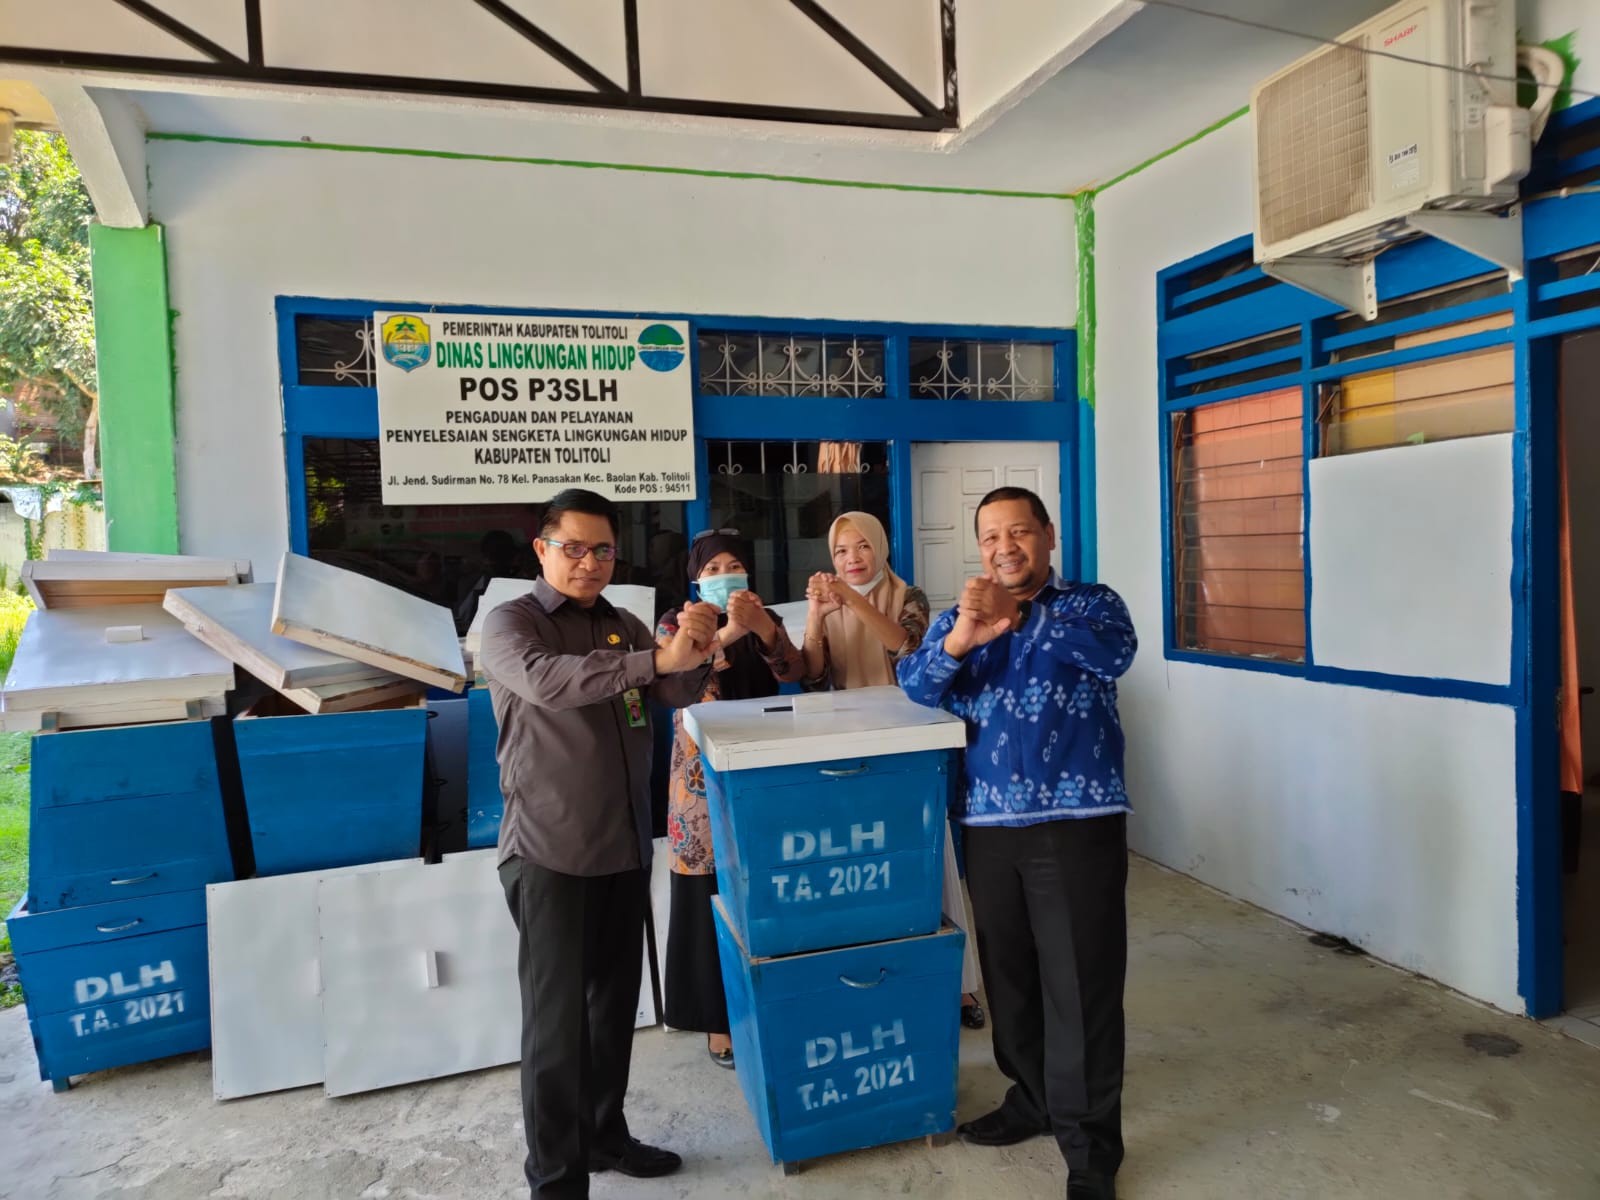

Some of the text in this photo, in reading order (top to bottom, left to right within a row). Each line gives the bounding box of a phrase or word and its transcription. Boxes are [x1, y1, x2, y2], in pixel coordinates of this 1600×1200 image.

[443, 321, 628, 340] PEMERINTAH KABUPATEN TOLITOLI
[436, 341, 636, 371] DINAS LINGKUNGAN HIDUP
[460, 377, 618, 402] POS P3SLH
[446, 410, 633, 424] PENGADUAN DAN PELAYANAN
[386, 429, 688, 443] PENYELESAIAN SENGKETA LINGKUNGAN HIDUP
[474, 447, 611, 464] KABUPATEN TOLITOLI
[387, 472, 690, 486] Jl. Jend. Sudirman No. 78 Kel. Panasakan Kec. Baolan Kab. Tolitoli
[614, 484, 637, 494] Kode
[639, 484, 658, 493] POS
[665, 483, 691, 493] 94511
[781, 821, 885, 861] DLH
[771, 860, 891, 904] T.A. 2021
[75, 960, 176, 1003] DLH
[70, 990, 185, 1037] T.A. 2021
[805, 1019, 906, 1068] DLH
[798, 1055, 915, 1111] T.A. 2021
